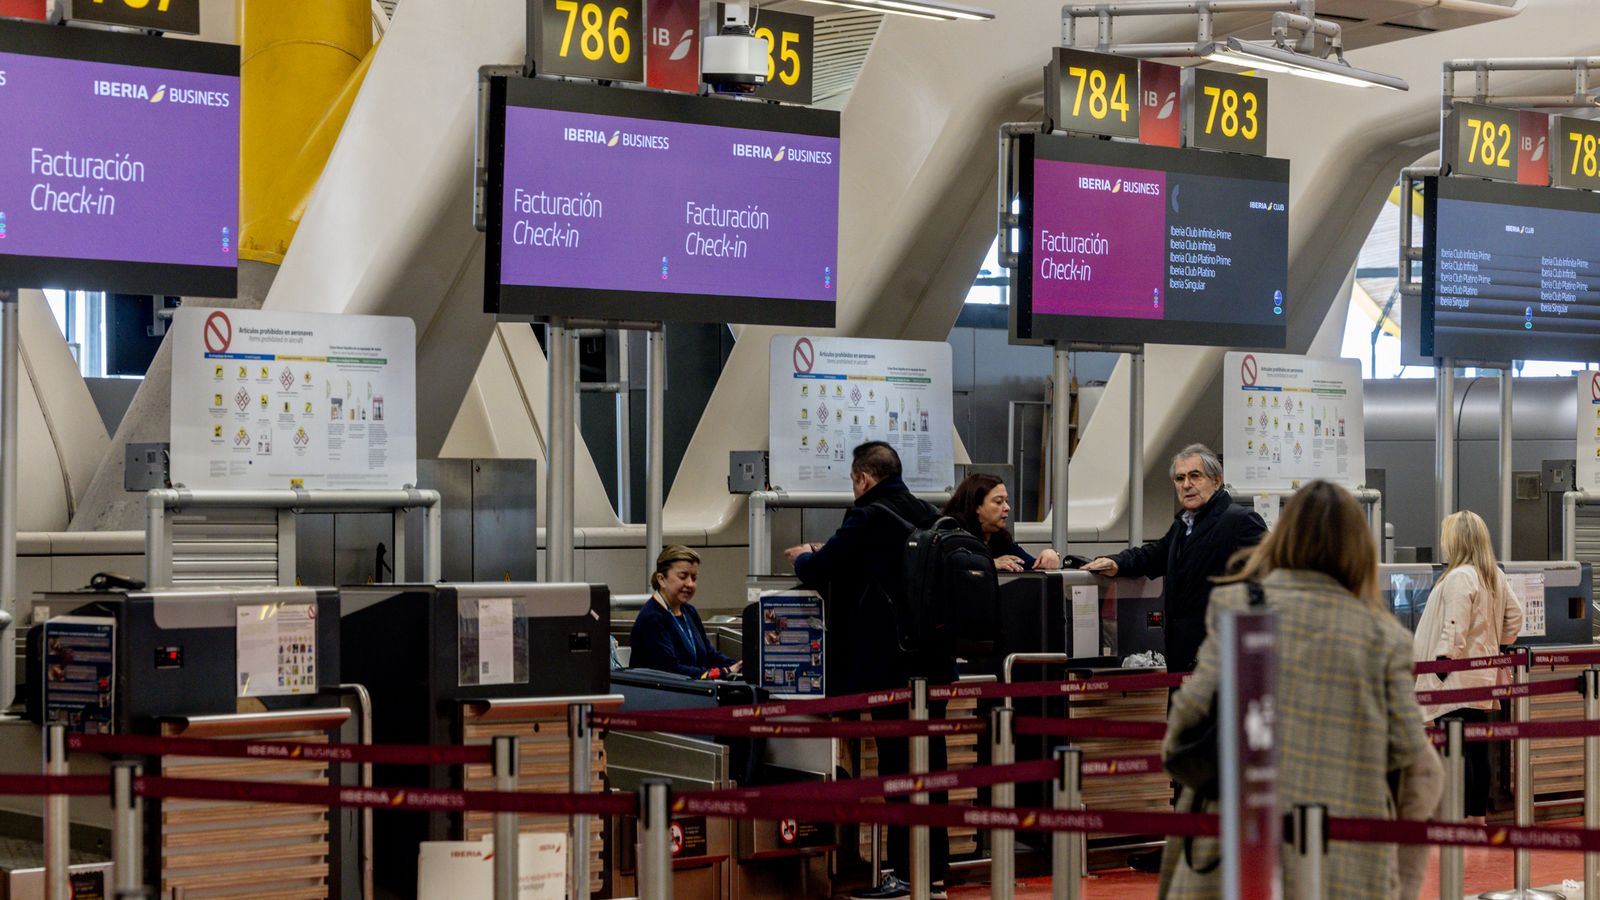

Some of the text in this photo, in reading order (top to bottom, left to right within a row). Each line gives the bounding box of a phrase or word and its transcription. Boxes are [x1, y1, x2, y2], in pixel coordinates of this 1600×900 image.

[556, 1, 632, 64] 786
[652, 27, 671, 47] IB
[94, 80, 230, 107] IBERIA BUSINESS
[1069, 66, 1130, 123] 784
[1143, 90, 1158, 107] IB
[1203, 86, 1258, 141] 783
[564, 127, 670, 150] IBERIA BUSINESS
[1466, 118, 1511, 169] 782
[1521, 136, 1532, 152] IB
[732, 143, 833, 165] IBERIA BUSINESS
[1569, 132, 1600, 178] 78
[30, 147, 145, 183] Facturación
[1078, 176, 1160, 196] IBERIA BUSINESS
[30, 184, 116, 216] Check-in
[514, 188, 603, 219] Facturación
[1249, 201, 1285, 211] IBERIA CLUB
[685, 201, 770, 231] Facturación
[513, 220, 580, 249] Check-in
[1171, 226, 1232, 241] Iberia Club Infinita Prime
[1505, 224, 1520, 233] IBERIA
[685, 232, 748, 259] Check-in
[1041, 229, 1109, 256] Facturación
[1170, 239, 1216, 252] Iberia Club Infinita
[1170, 252, 1231, 266] Iberia Club Platino Prime
[1040, 257, 1092, 282] Check-in
[1170, 265, 1215, 278] Iberia Club Platino
[1170, 278, 1206, 292] Iberia Singular
[1470, 657, 1512, 668] IBERIA BUSINESS
[1535, 655, 1570, 663] IBERIA BUSINESS
[930, 687, 982, 698] IBERIA BUSINESS
[1060, 681, 1109, 692] IBERIA BUSINESS
[1491, 685, 1529, 697] IBERIA BUSINESS
[868, 694, 889, 705] IBERIA
[732, 705, 787, 718] IBERIA BUSINESS
[610, 717, 637, 726] BUSINESS
[749, 725, 774, 733] IBERIA
[929, 724, 954, 732] IBERIA
[1465, 726, 1519, 738] IBERIA BUSINESS
[247, 744, 353, 759] IBERIA BUSINESS
[1082, 759, 1148, 775] IBERIA BUSINESS
[884, 774, 959, 793] IBERIA BUSINESS
[340, 790, 465, 807] IBERIA BUSINESS
[688, 799, 748, 814] BUSINESS
[964, 811, 1103, 829] IBERIA BUSINESS
[1427, 827, 1582, 847] IBERIA BUSINESS
[450, 850, 483, 859] IBERIA
